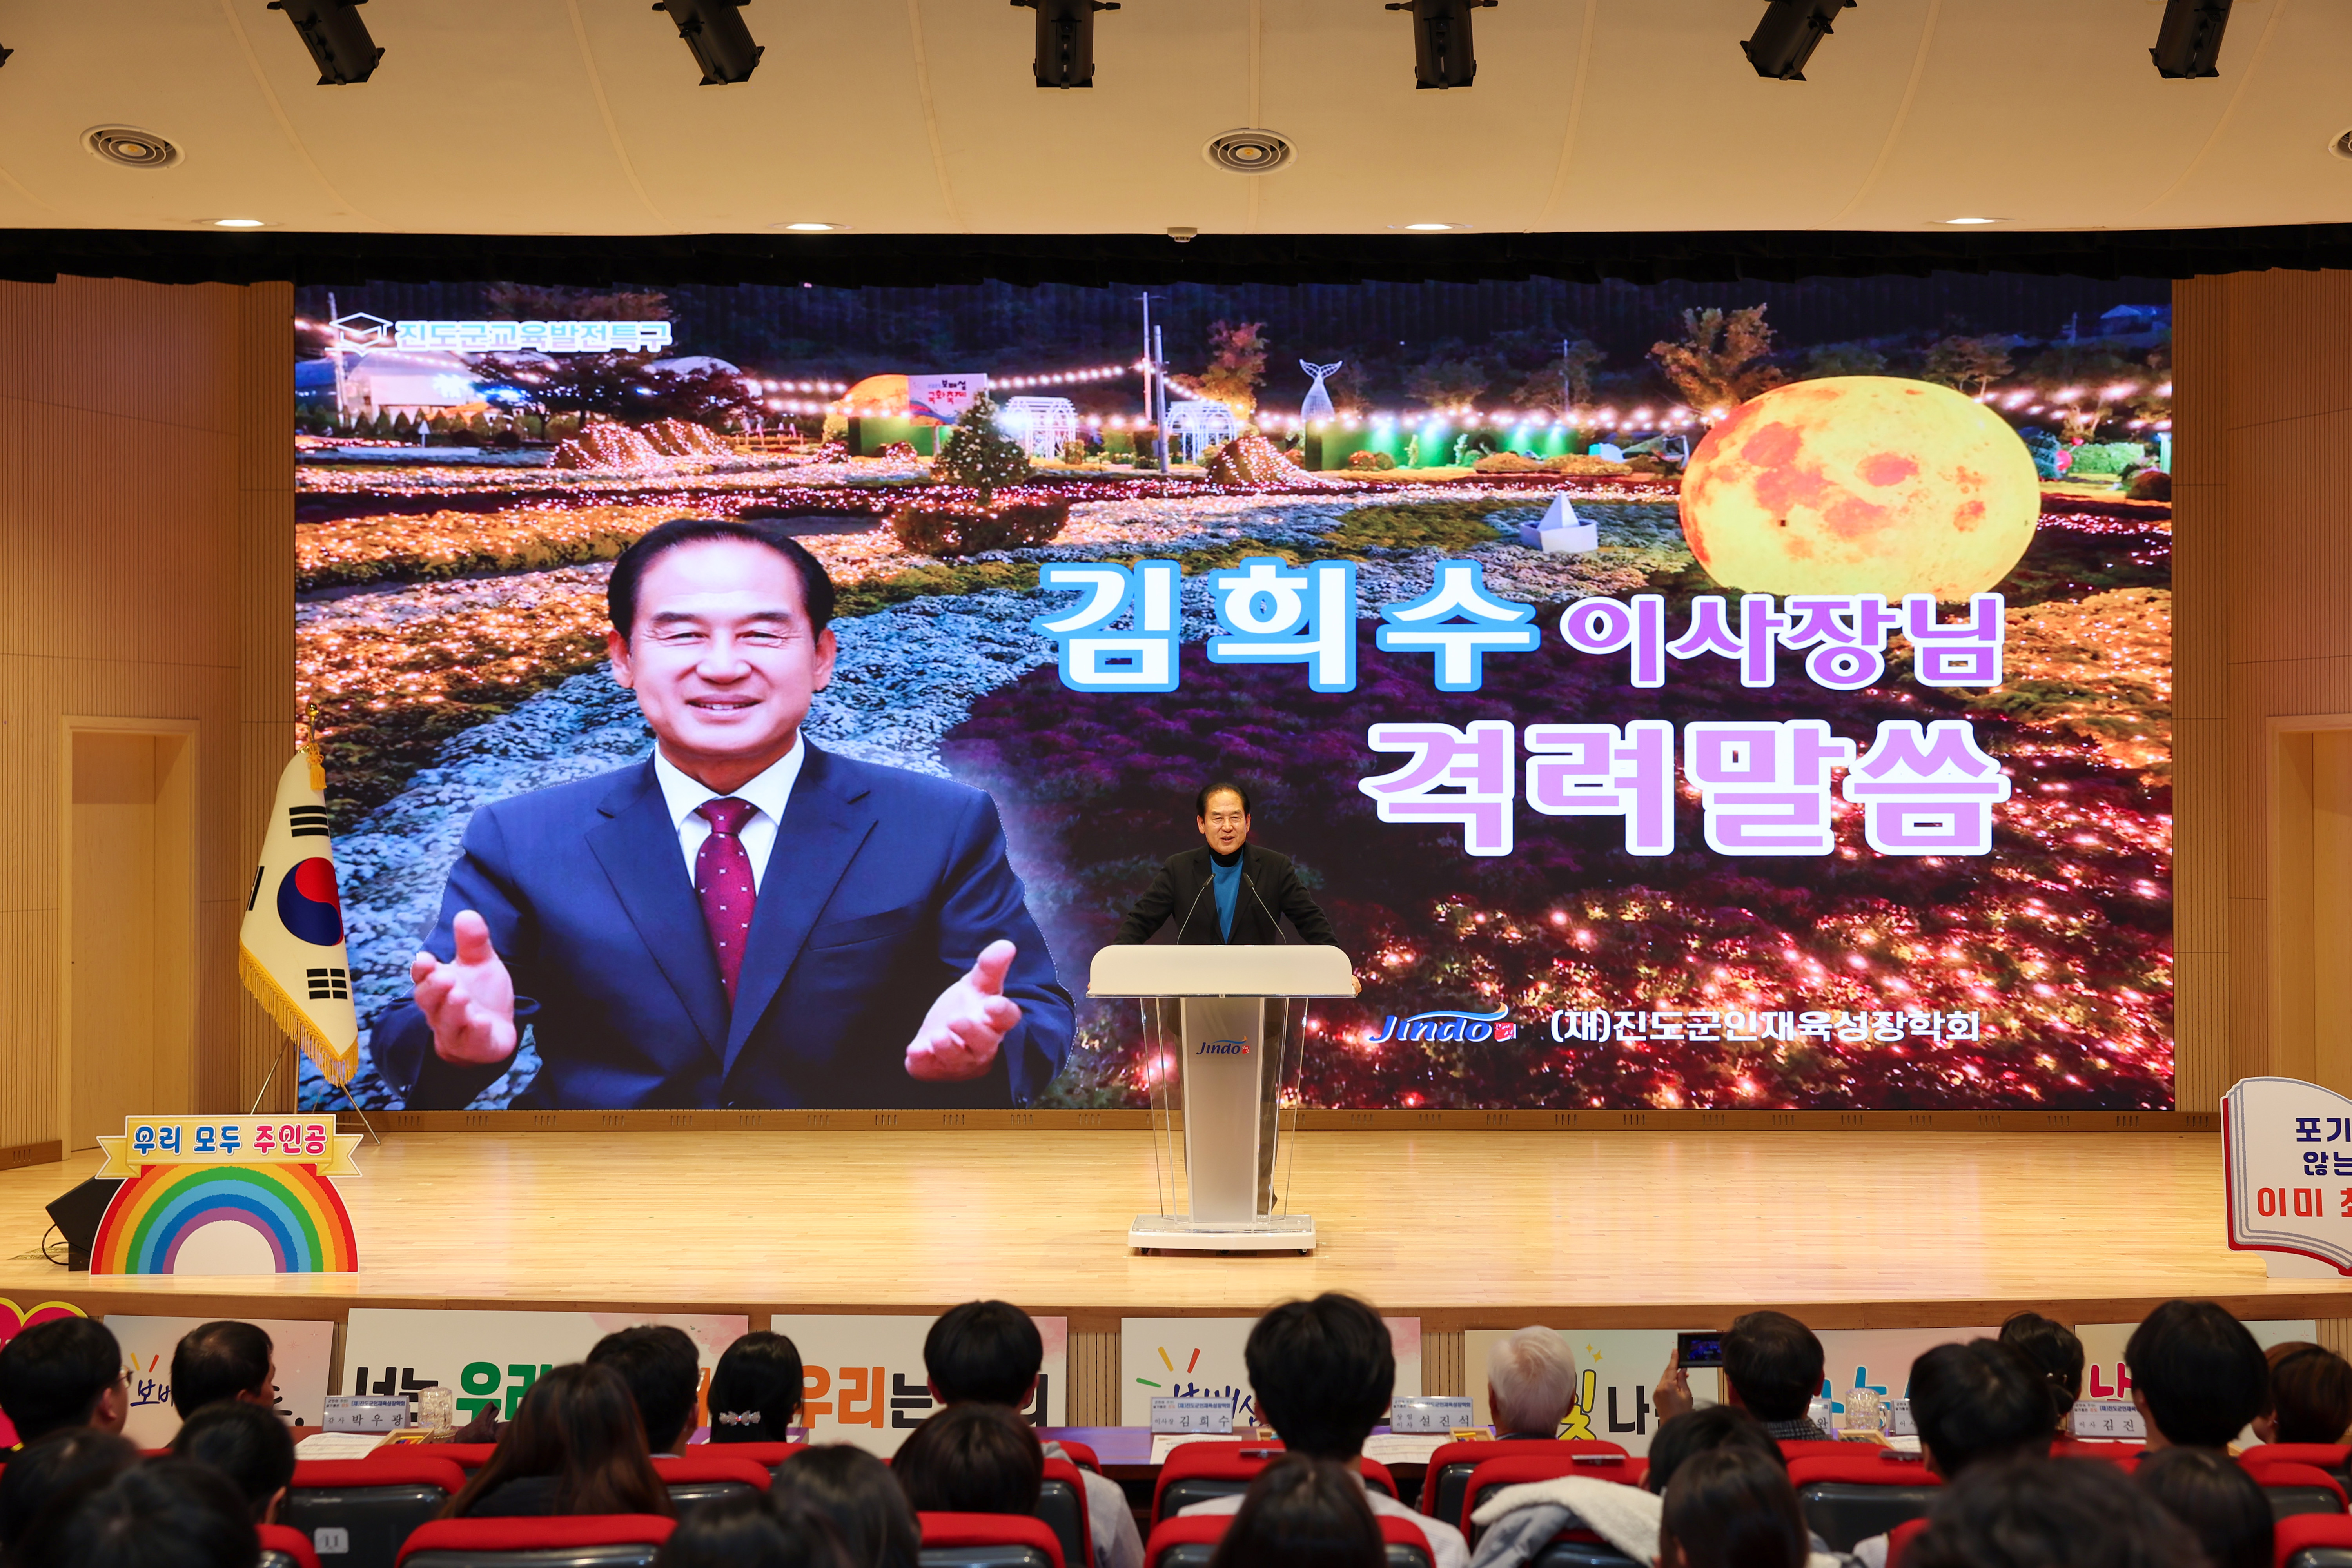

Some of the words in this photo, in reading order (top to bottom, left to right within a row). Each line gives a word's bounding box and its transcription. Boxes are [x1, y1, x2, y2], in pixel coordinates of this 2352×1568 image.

[394, 321, 672, 352] 진도군교육발전특구
[1032, 557, 1540, 692] 김희수
[1559, 593, 2004, 690] 이사장님
[1359, 720, 2011, 856] 격려말씀
[1369, 1015, 1492, 1043] Jindo
[1551, 1010, 1981, 1042] (재)진도군인재육성장학회
[1196, 1042, 1241, 1055] Jindo
[133, 1124, 182, 1156] 우리
[193, 1124, 242, 1156] 모두
[252, 1123, 328, 1156] 주인공
[2257, 1187, 2323, 1217] 이미
